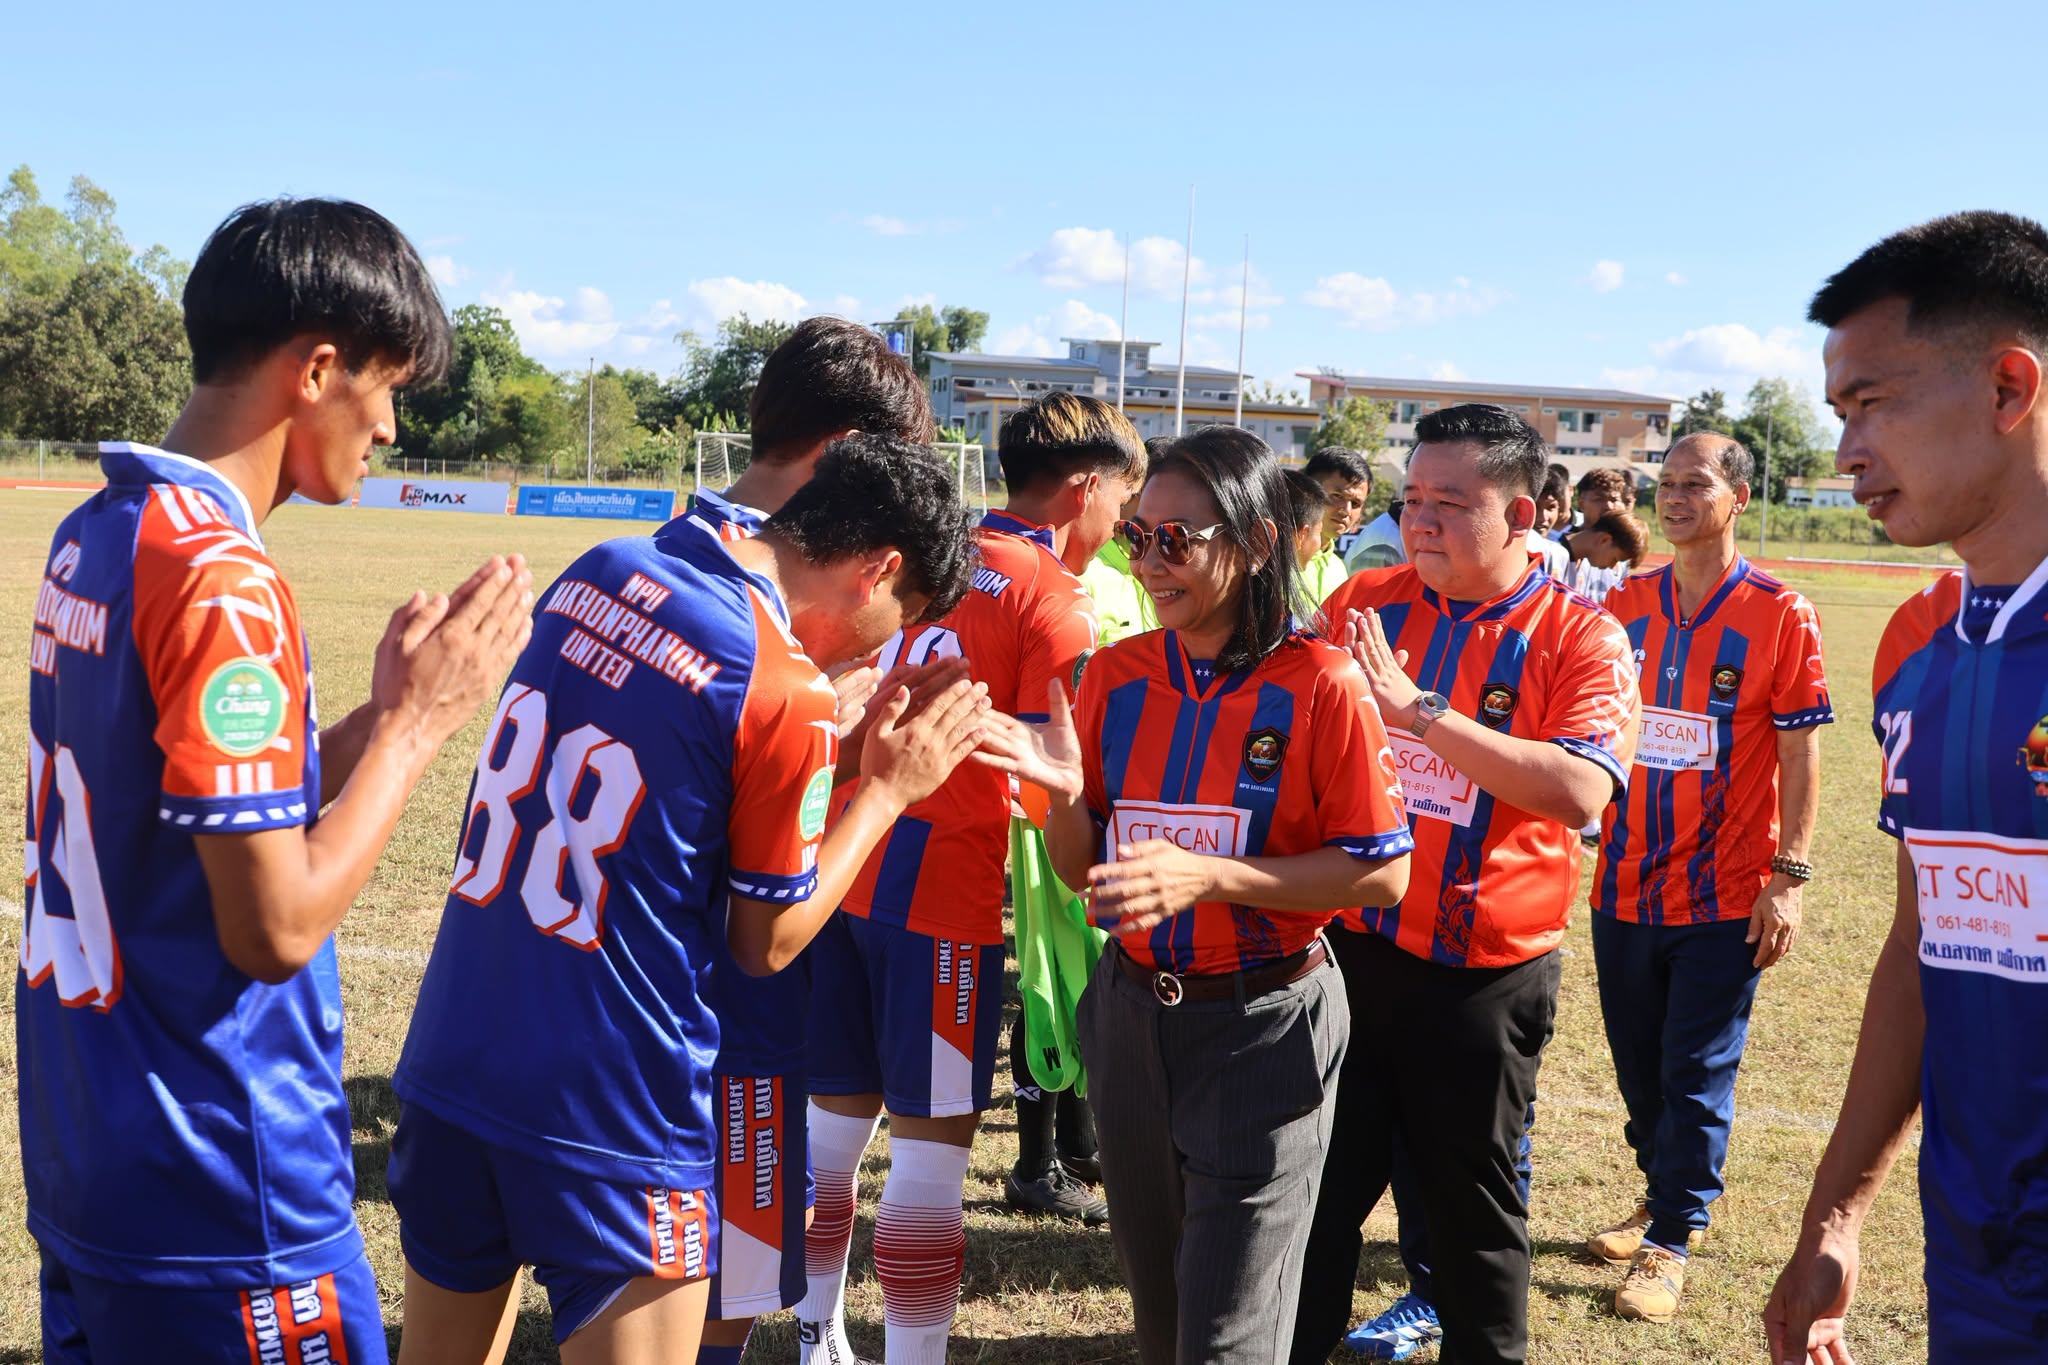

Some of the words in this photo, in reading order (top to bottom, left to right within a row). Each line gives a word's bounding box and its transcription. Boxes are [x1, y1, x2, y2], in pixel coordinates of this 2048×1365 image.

[424, 493, 467, 504] MAX
[619, 571, 672, 614] NPU
[545, 580, 722, 696] NAKHONPHANOM
[560, 626, 635, 691] UNITED
[216, 697, 272, 717] Chang
[1655, 722, 1697, 743] SCAN
[1396, 750, 1456, 781] SCAN
[1400, 778, 1436, 794] 81-8151
[451, 681, 647, 952] 88
[1162, 827, 1219, 852] SCAN
[1955, 865, 2029, 908] SCAN
[1937, 915, 2010, 938] 061-481-8151
[729, 1077, 745, 1163] .นครพนม
